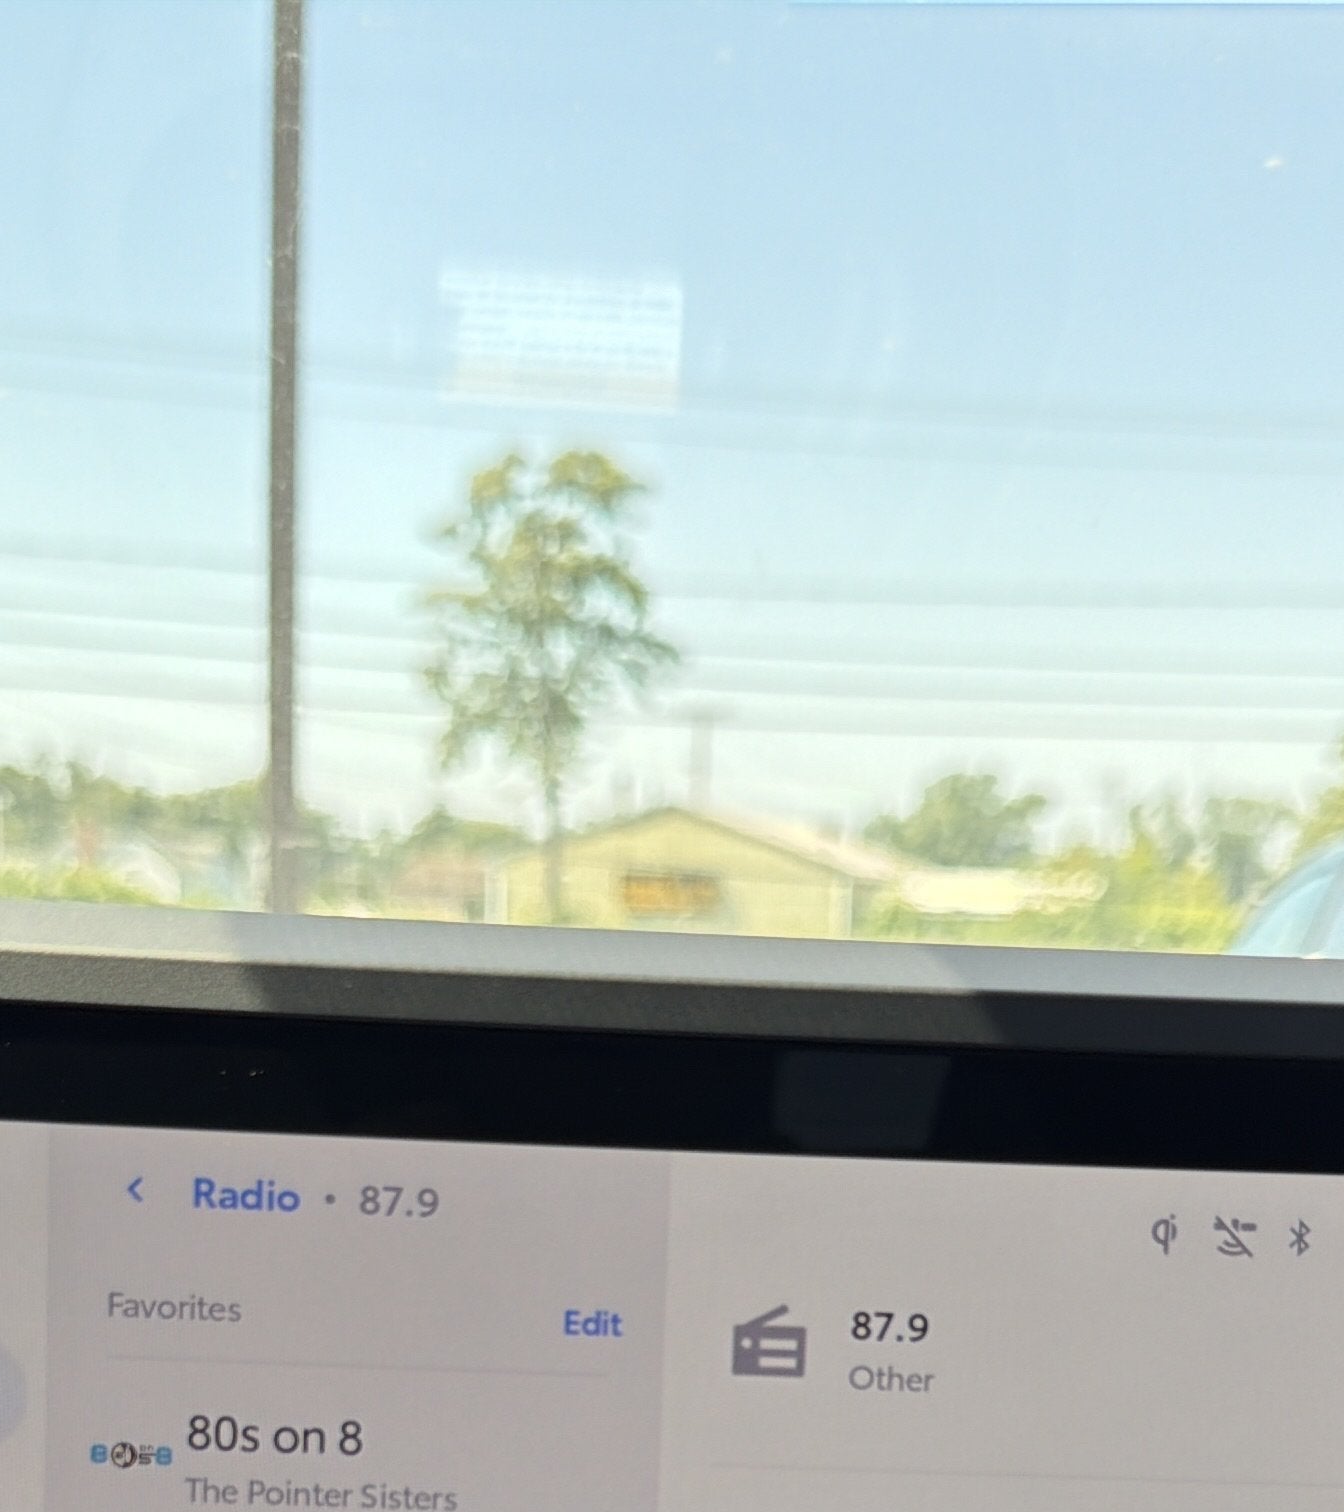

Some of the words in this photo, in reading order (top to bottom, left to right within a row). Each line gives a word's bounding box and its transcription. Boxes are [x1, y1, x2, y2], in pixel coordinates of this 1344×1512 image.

[193, 1176, 301, 1214] Radio
[359, 1186, 440, 1219] 87.9
[107, 1292, 242, 1324] Favorites
[563, 1309, 624, 1339] Edit
[851, 1311, 930, 1344] 87.9
[849, 1364, 935, 1394] Other
[187, 1415, 260, 1455] 80s
[273, 1427, 326, 1456] on
[338, 1420, 364, 1456] 8
[185, 1477, 239, 1505] The
[248, 1479, 353, 1509] Pointer
[361, 1483, 458, 1512] Sisters
